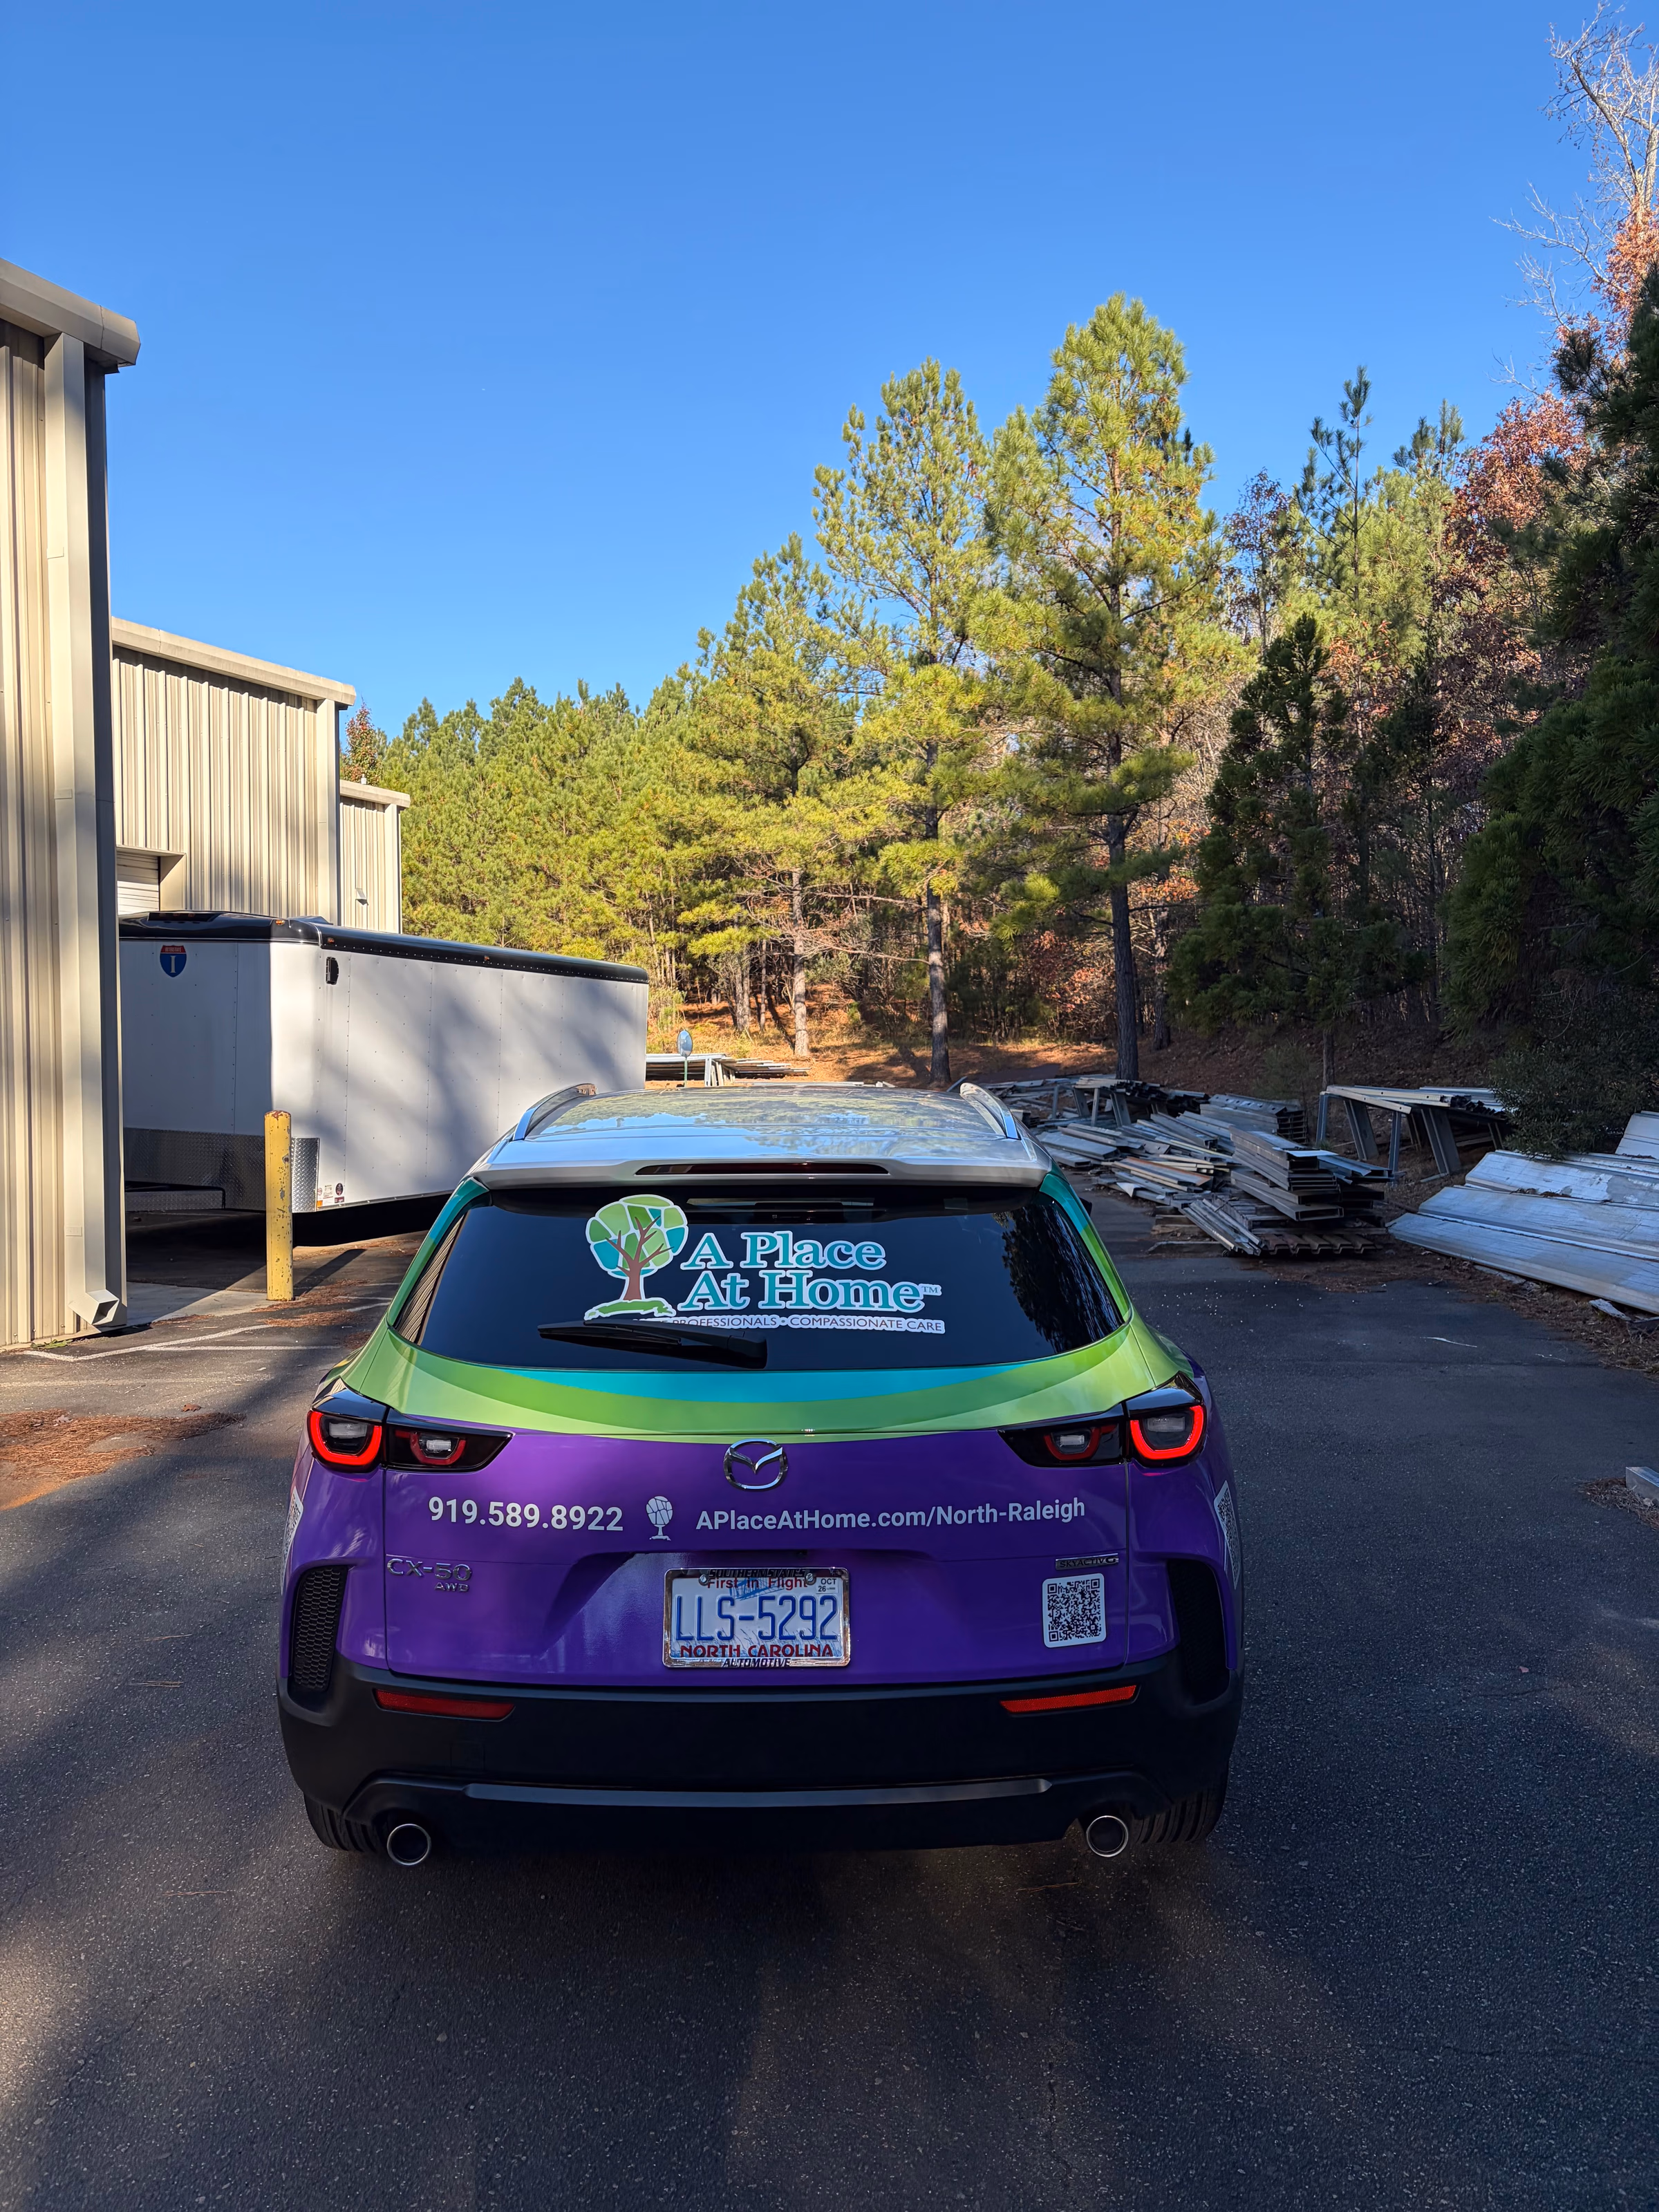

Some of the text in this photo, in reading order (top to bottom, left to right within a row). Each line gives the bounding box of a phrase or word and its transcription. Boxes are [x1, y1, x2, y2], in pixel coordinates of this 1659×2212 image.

[683, 1232, 883, 1268] A Place
[680, 1272, 748, 1309] At
[789, 1317, 903, 1329] COMPASSIONATE
[906, 1320, 942, 1331] CARE
[428, 1496, 624, 1532] 919.589.8922
[695, 1497, 1086, 1530] APlaceAtHome.com/North-Raleigh
[387, 1558, 471, 1581] CX-50
[434, 1582, 469, 1592] AWD
[707, 1577, 807, 1590] First in Flight
[675, 1595, 838, 1641] LLS-5292
[680, 1644, 834, 1657] NORTH CAROLINA
[722, 1658, 791, 1668] AUTOMOTIVE
